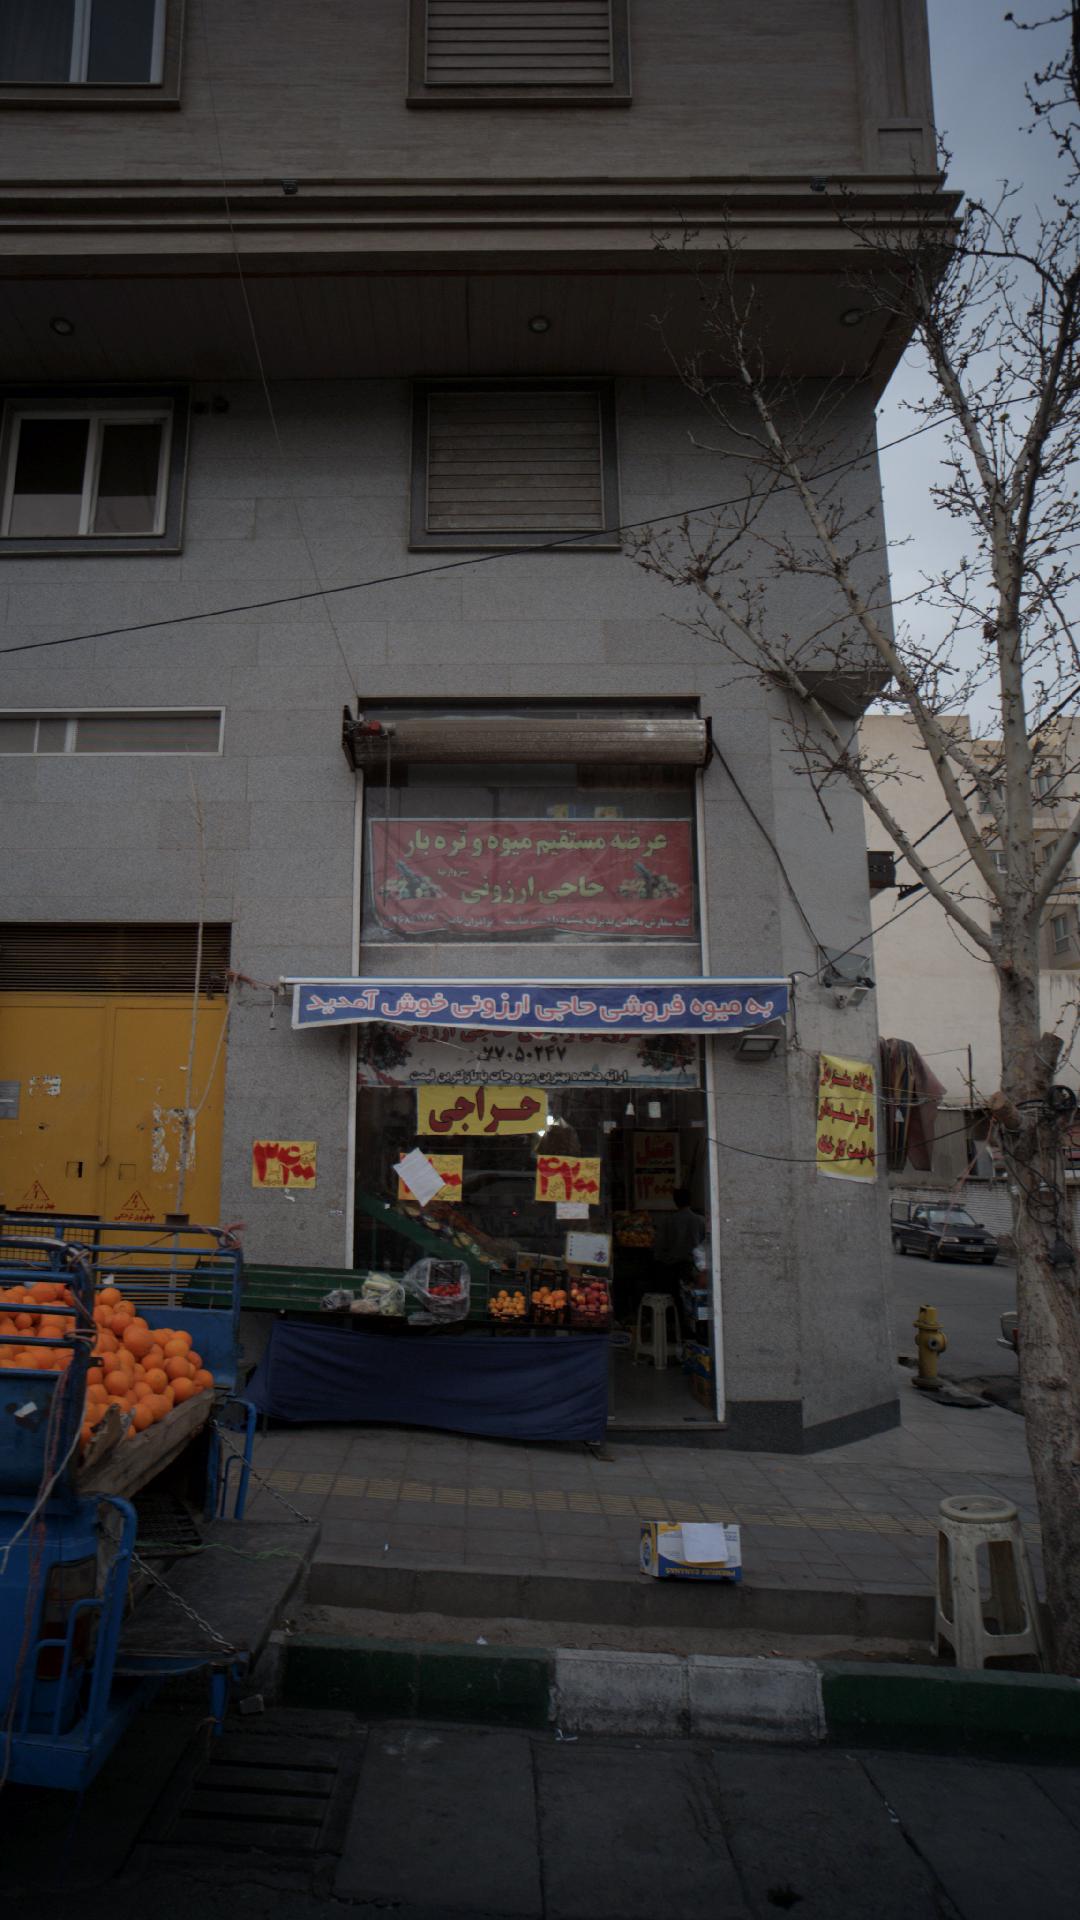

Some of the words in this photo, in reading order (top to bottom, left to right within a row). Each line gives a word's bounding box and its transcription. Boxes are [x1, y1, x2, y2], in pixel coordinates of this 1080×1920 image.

[404, 826, 430, 858] بار
[434, 827, 467, 858] تره
[470, 837, 482, 857] و
[487, 831, 532, 857] میوه
[536, 828, 606, 857] مستقیم
[611, 828, 668, 857] عرضه
[461, 874, 535, 905] ارزونی
[538, 876, 605, 906] حاجی
[306, 989, 380, 1013] آمدید
[381, 992, 449, 1018] خوش
[450, 992, 530, 1022] ارزونی
[534, 991, 597, 1023] حاجی
[600, 994, 687, 1024] فروشی
[689, 996, 741, 1023] میوه
[745, 994, 775, 1022] به
[429, 1085, 543, 1134] حراجی
